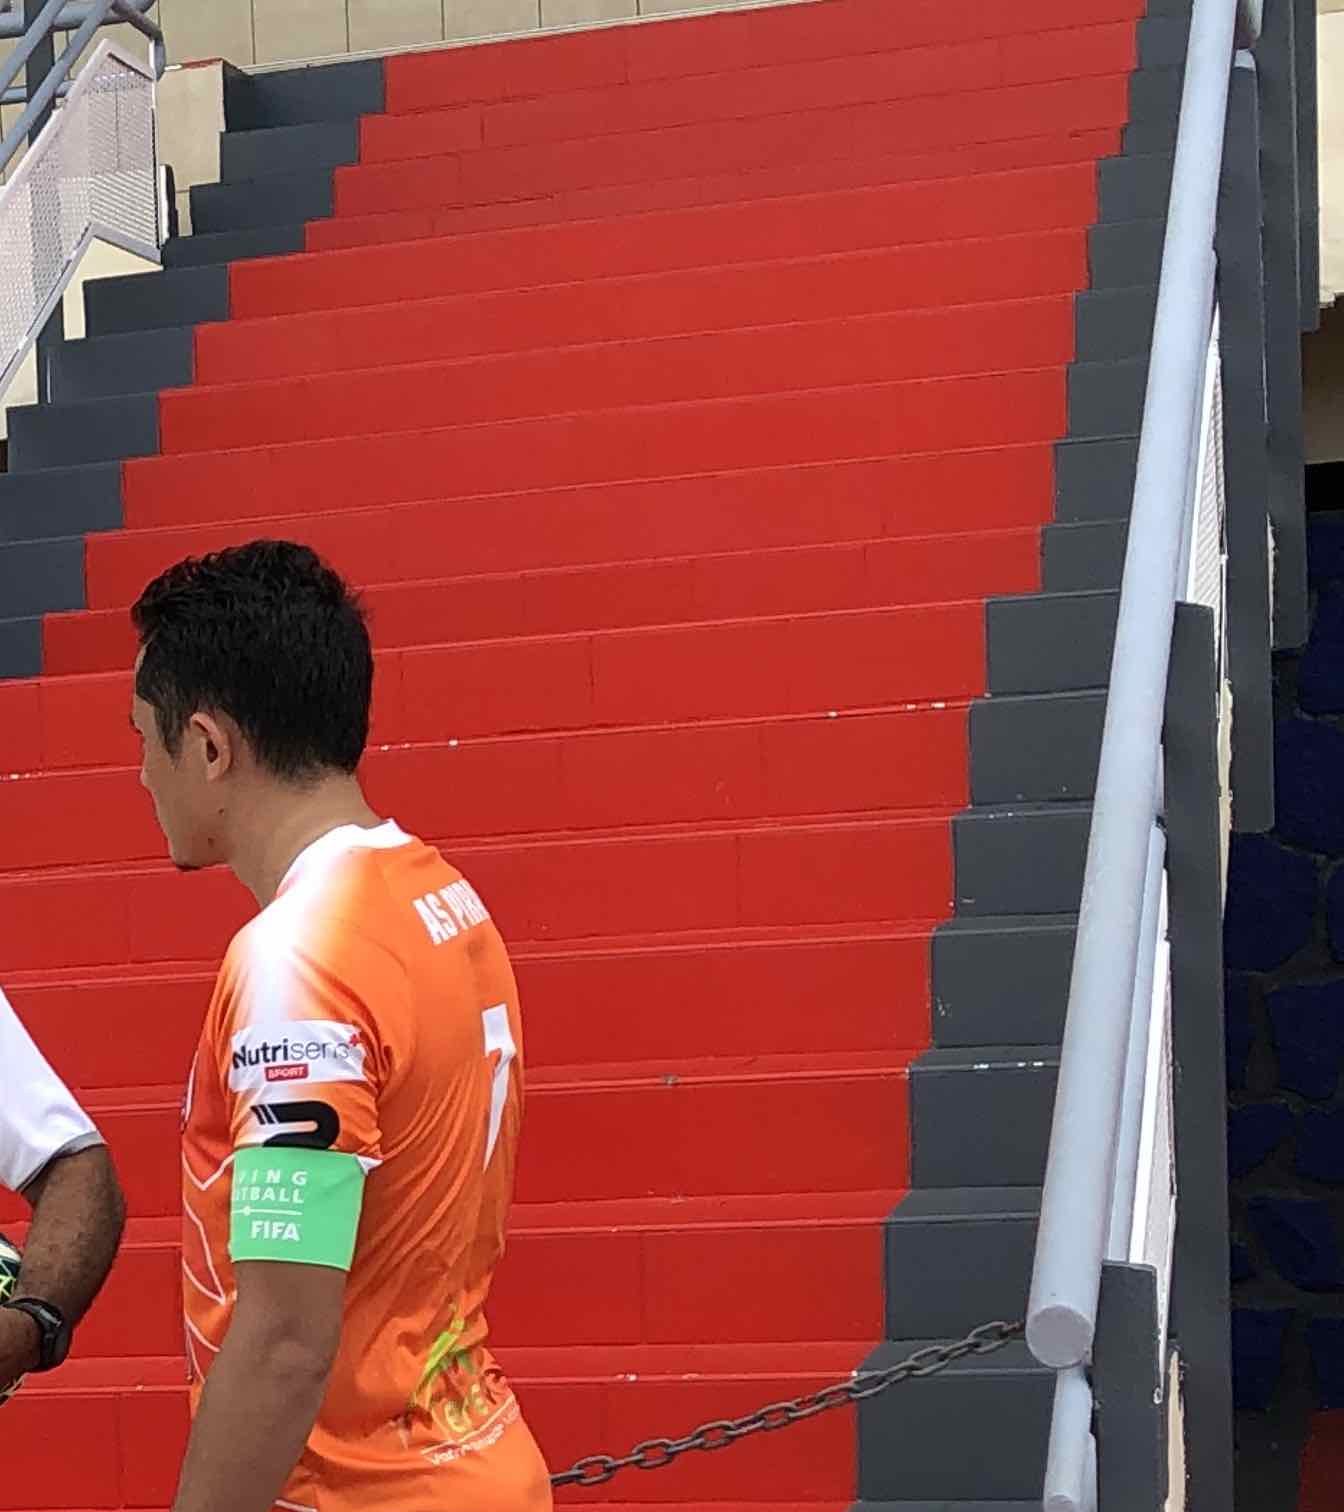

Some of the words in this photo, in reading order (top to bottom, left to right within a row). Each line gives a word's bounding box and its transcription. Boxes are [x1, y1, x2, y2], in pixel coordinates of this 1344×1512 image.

[413, 892, 458, 945] AS
[482, 1003, 516, 1174] 7
[251, 1220, 300, 1241] FIFA
